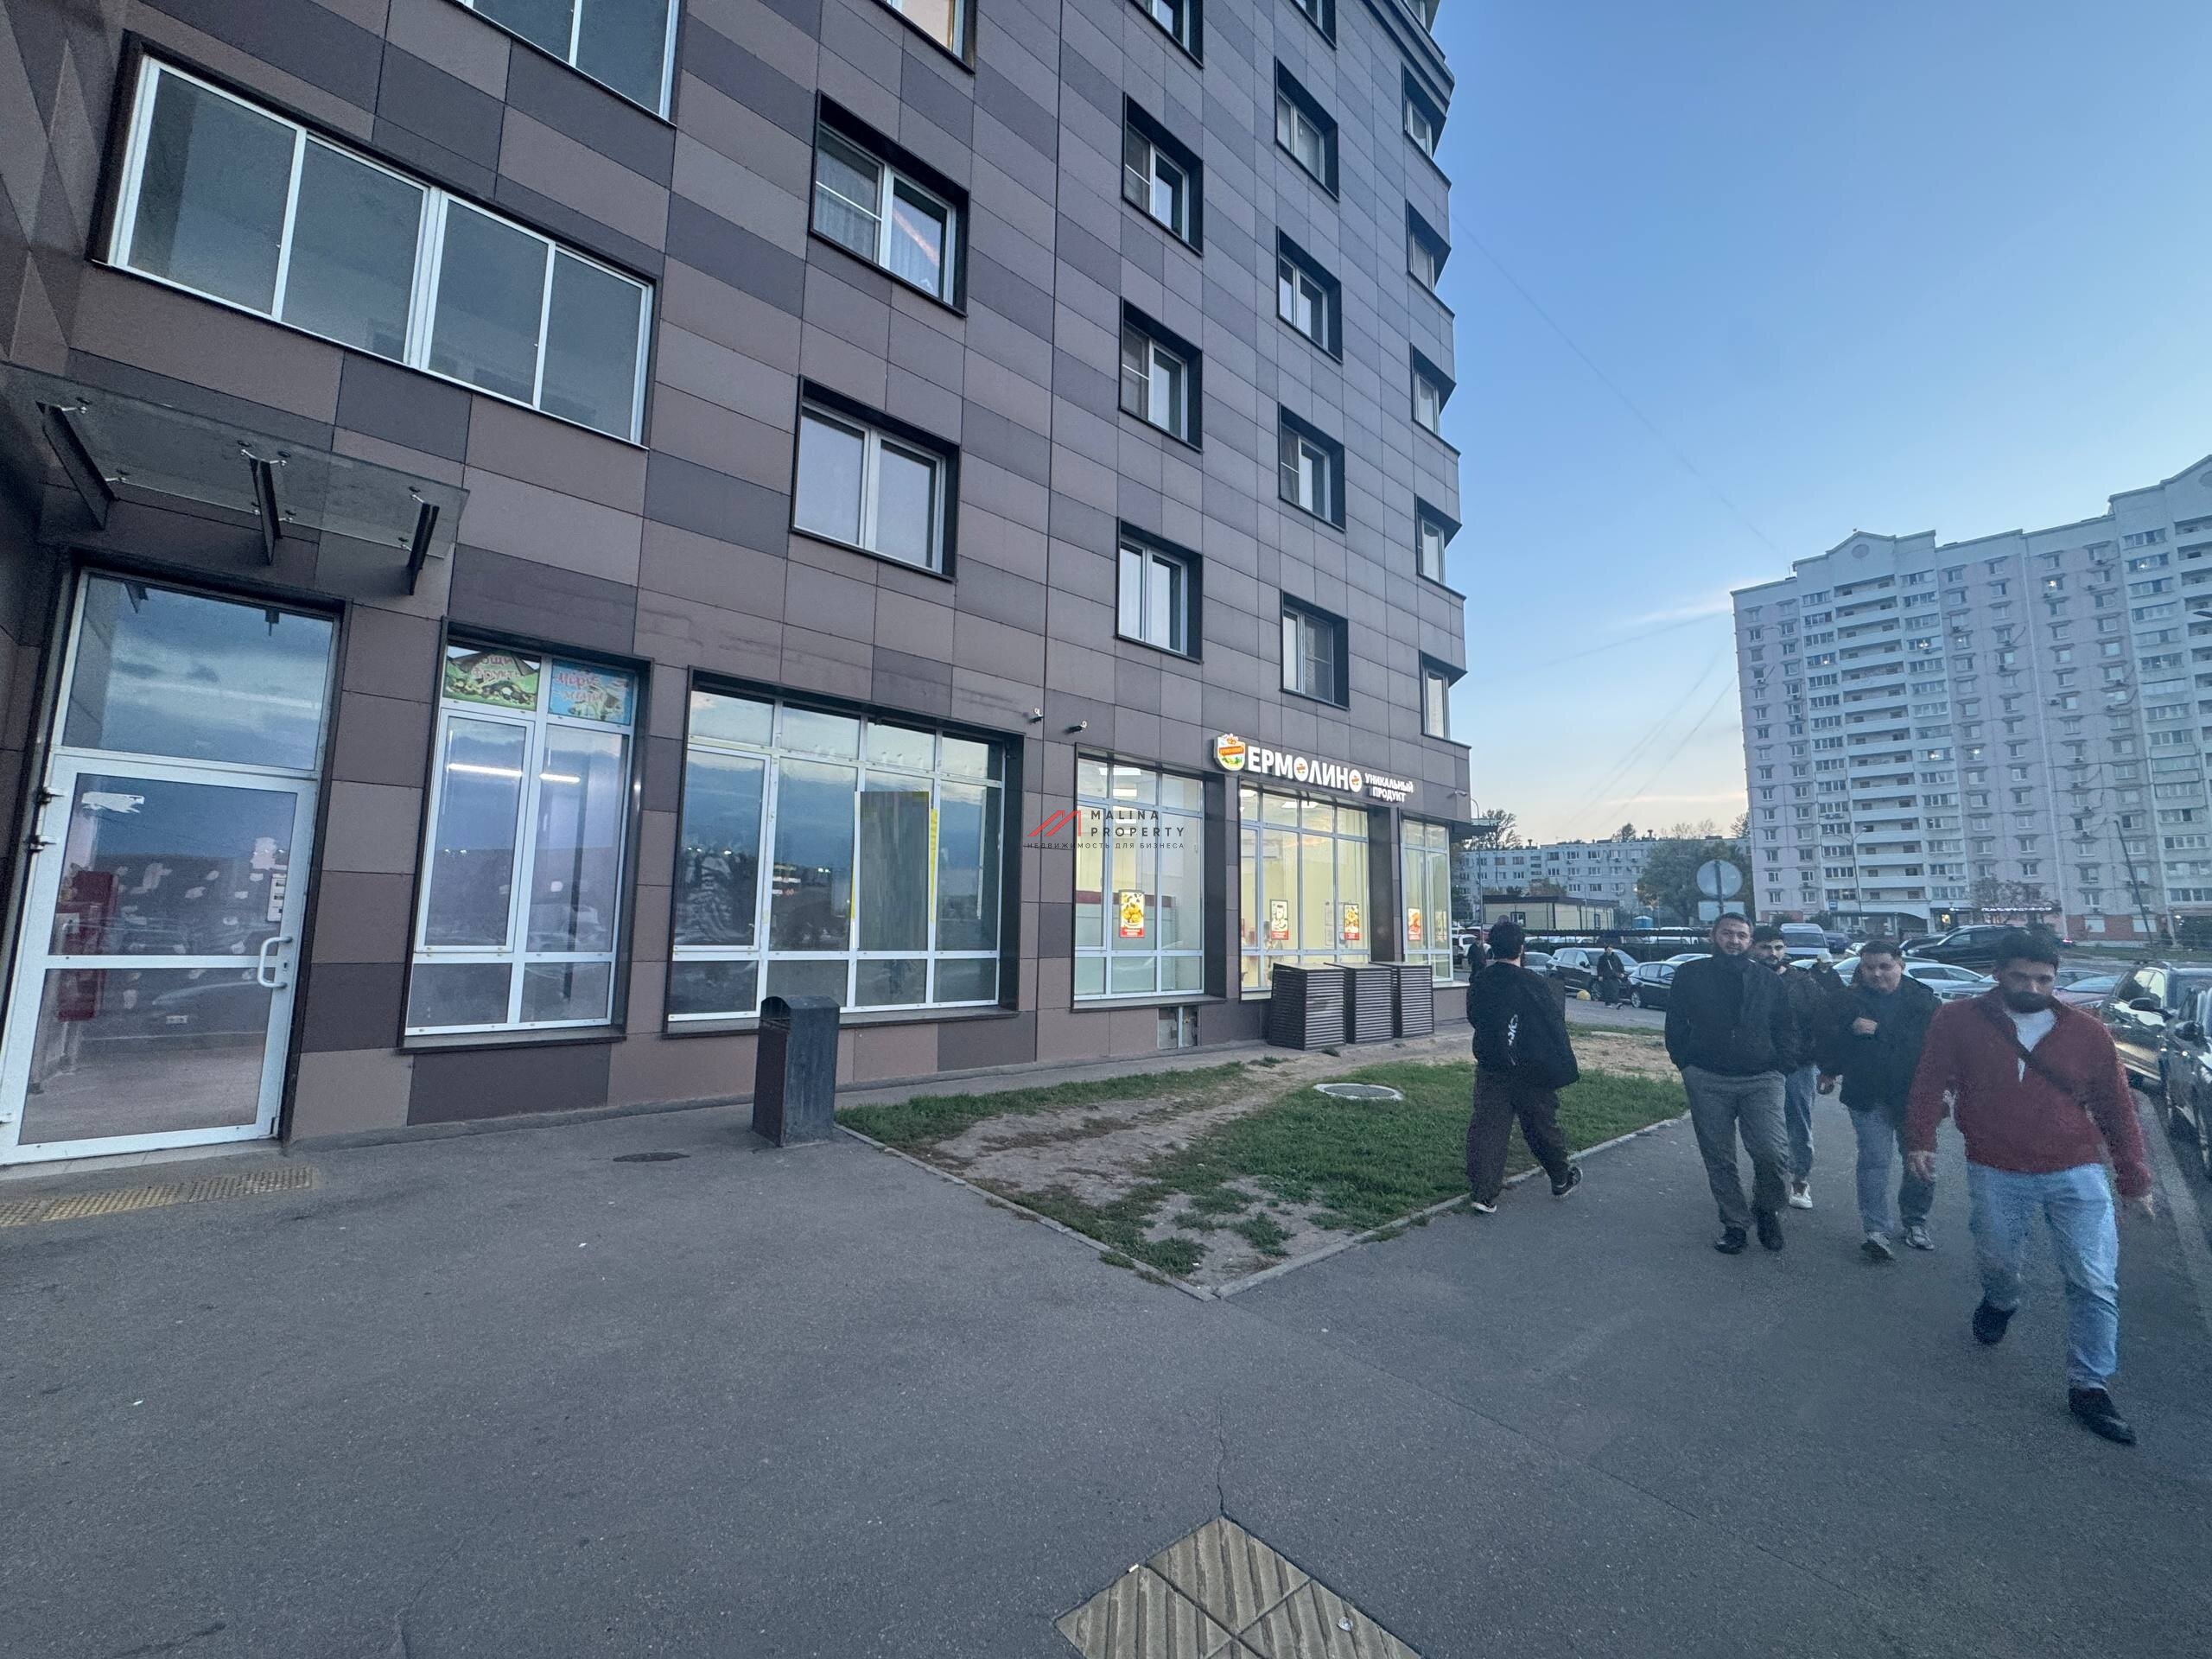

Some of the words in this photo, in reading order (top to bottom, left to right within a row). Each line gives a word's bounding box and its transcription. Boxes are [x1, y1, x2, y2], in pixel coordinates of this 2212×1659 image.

[1247, 746, 1363, 793] ЕРМОЛИНО
[1364, 772, 1414, 793] УНИКАЛЬНЫЙ
[1372, 786, 1407, 803] ПРОДУКТ
